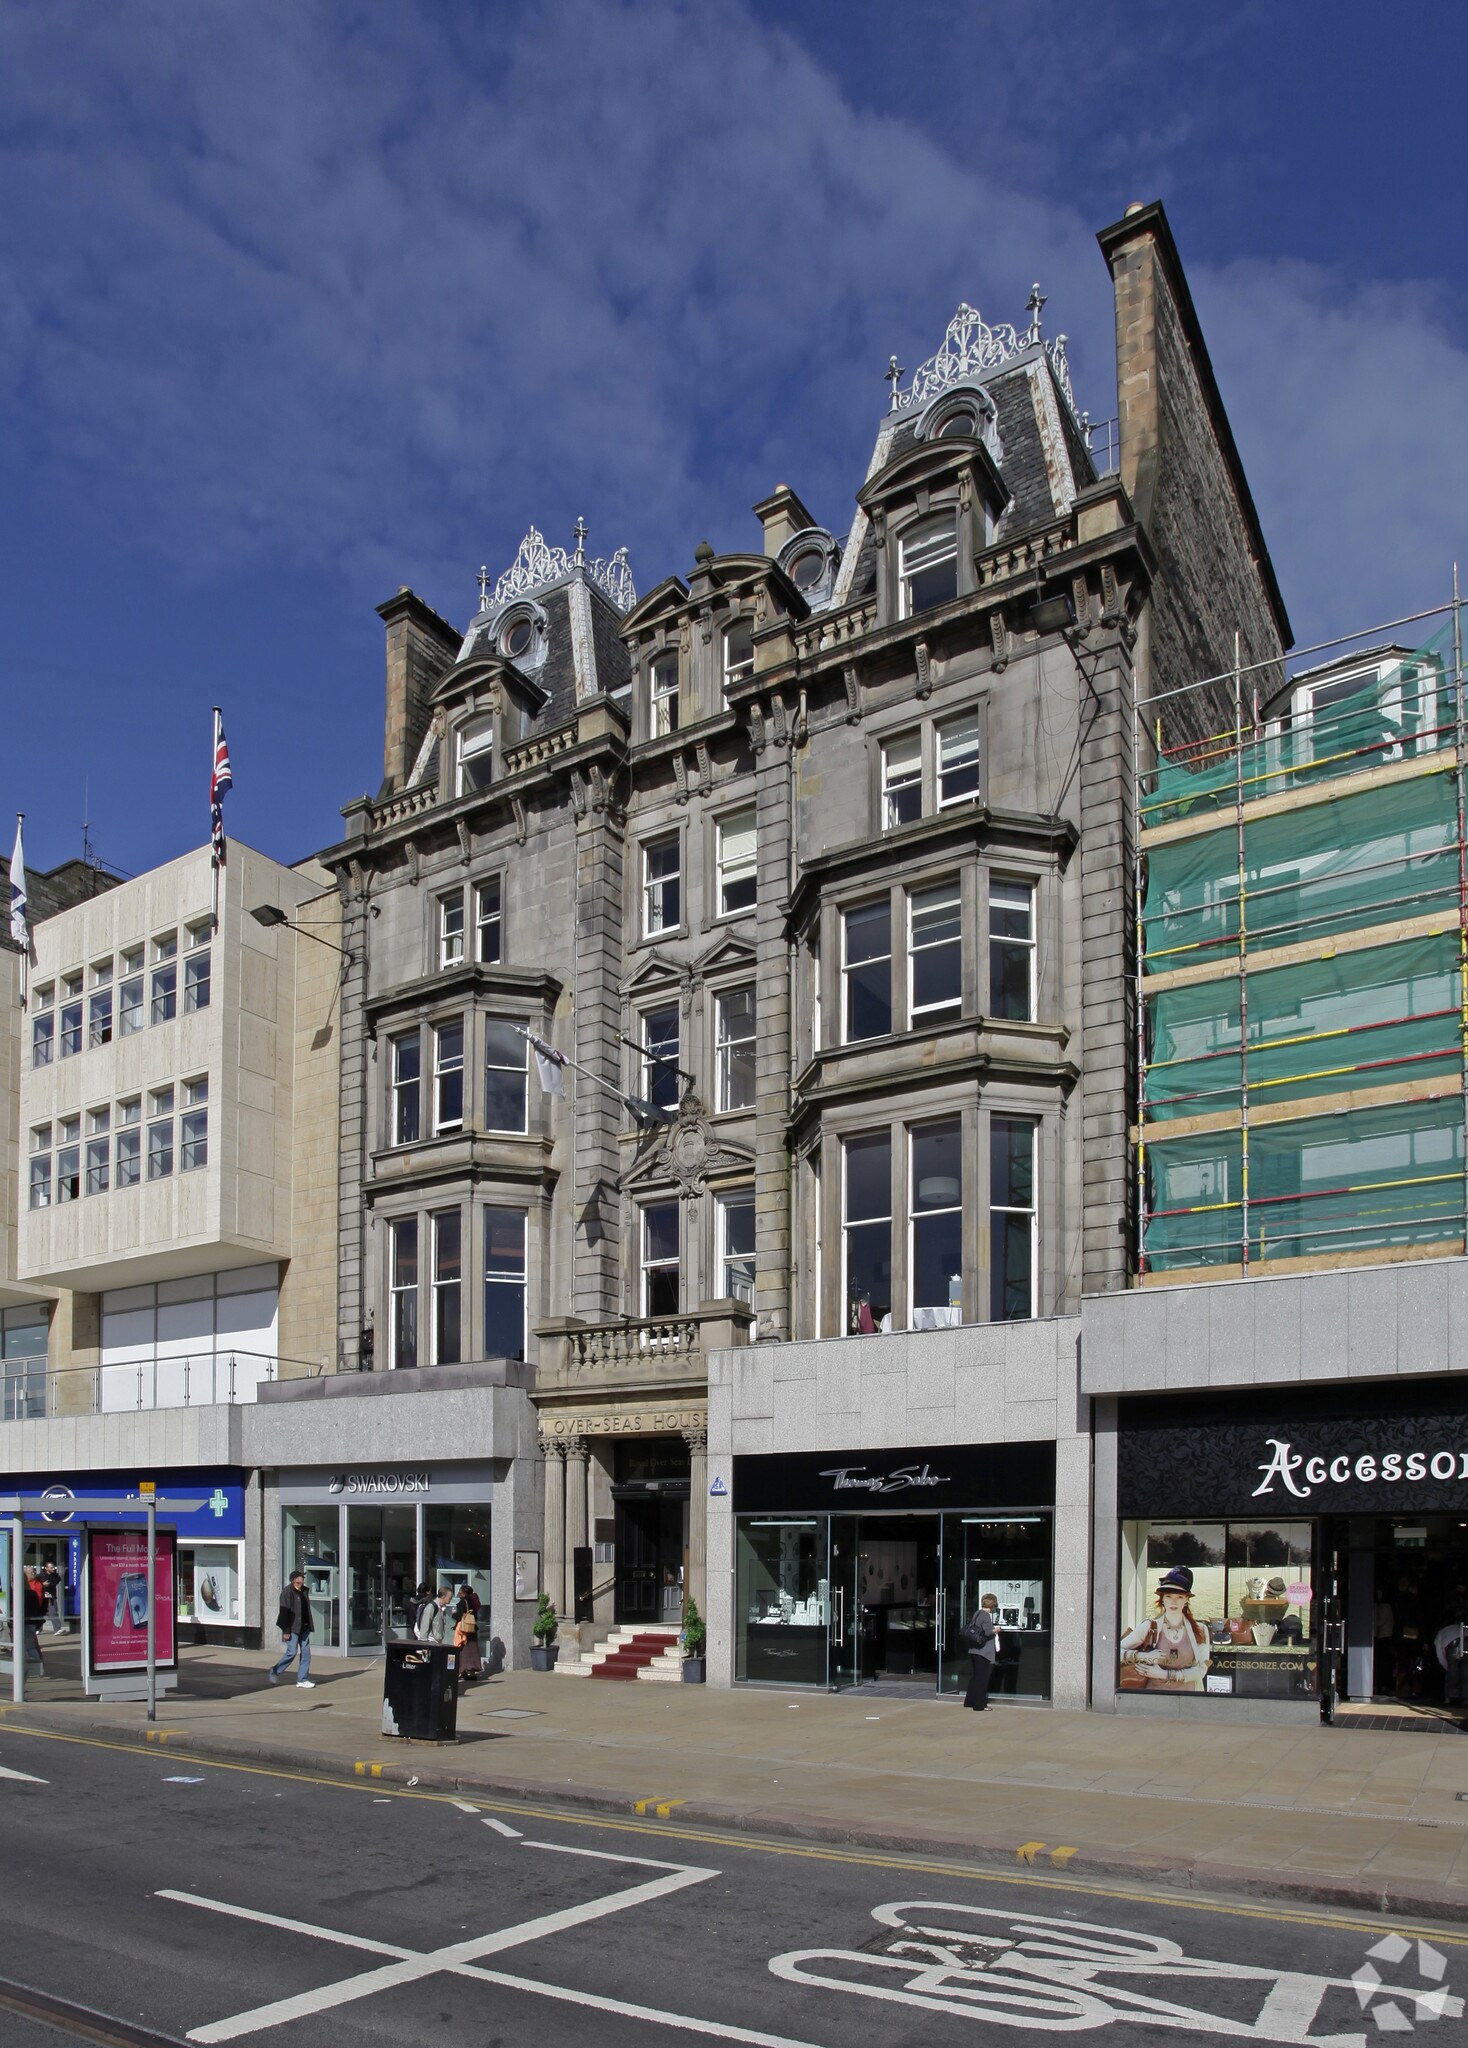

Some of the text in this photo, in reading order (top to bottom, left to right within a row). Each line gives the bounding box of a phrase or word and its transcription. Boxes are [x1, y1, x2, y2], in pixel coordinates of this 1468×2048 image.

[554, 1412, 708, 1434] OVER-SEAS HOUSE
[348, 1474, 430, 1493] SWAROVSKI
[819, 1464, 951, 1492] Thomas Sabo
[106, 1544, 160, 1554] The Full Moy
[1216, 1660, 1304, 1671] ACCESSORIZE.COM
